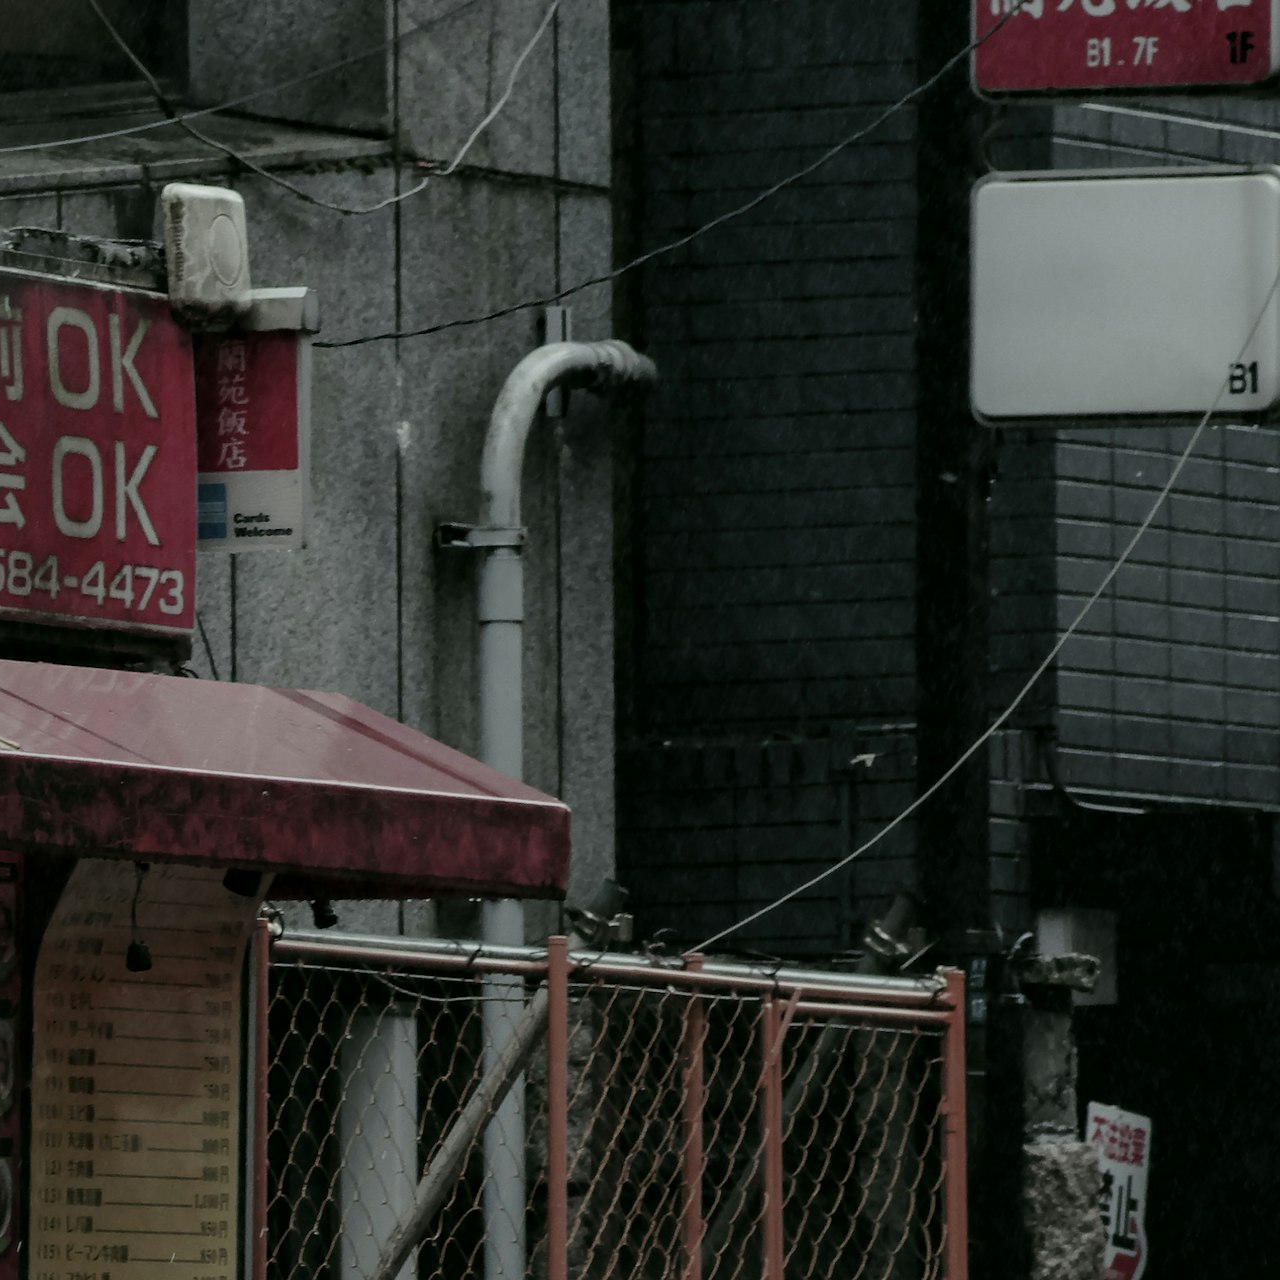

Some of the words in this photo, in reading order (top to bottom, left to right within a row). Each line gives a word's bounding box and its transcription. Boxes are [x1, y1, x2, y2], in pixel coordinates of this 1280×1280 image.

[1226, 31, 1254, 64] 1F
[1228, 361, 1258, 394] B1
[233, 512, 271, 524] Cards
[233, 526, 293, 538] Welcome
[37, 1243, 61, 1260] (15)
